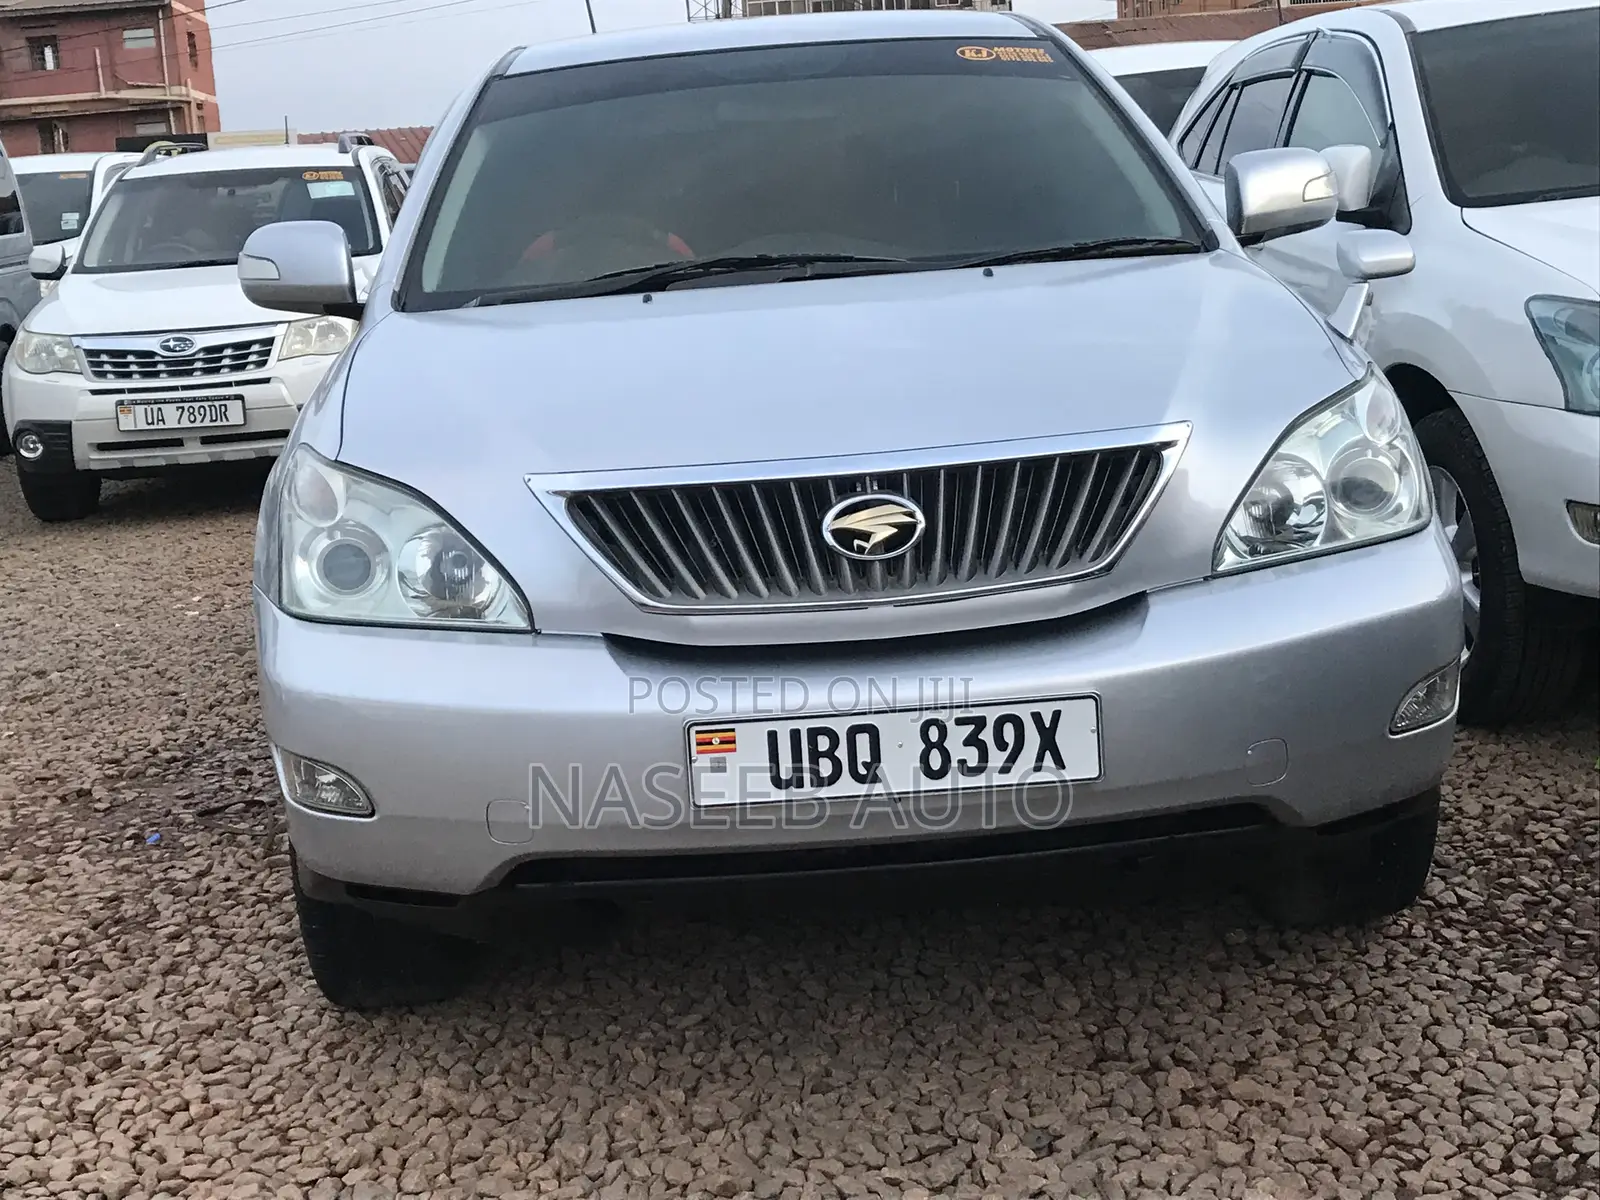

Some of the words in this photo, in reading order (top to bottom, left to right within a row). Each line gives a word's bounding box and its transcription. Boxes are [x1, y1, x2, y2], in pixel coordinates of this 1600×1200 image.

[144, 407, 166, 426] UA
[176, 404, 229, 425] 789DR
[767, 722, 882, 790] UBQ
[919, 709, 1066, 781] 839X
